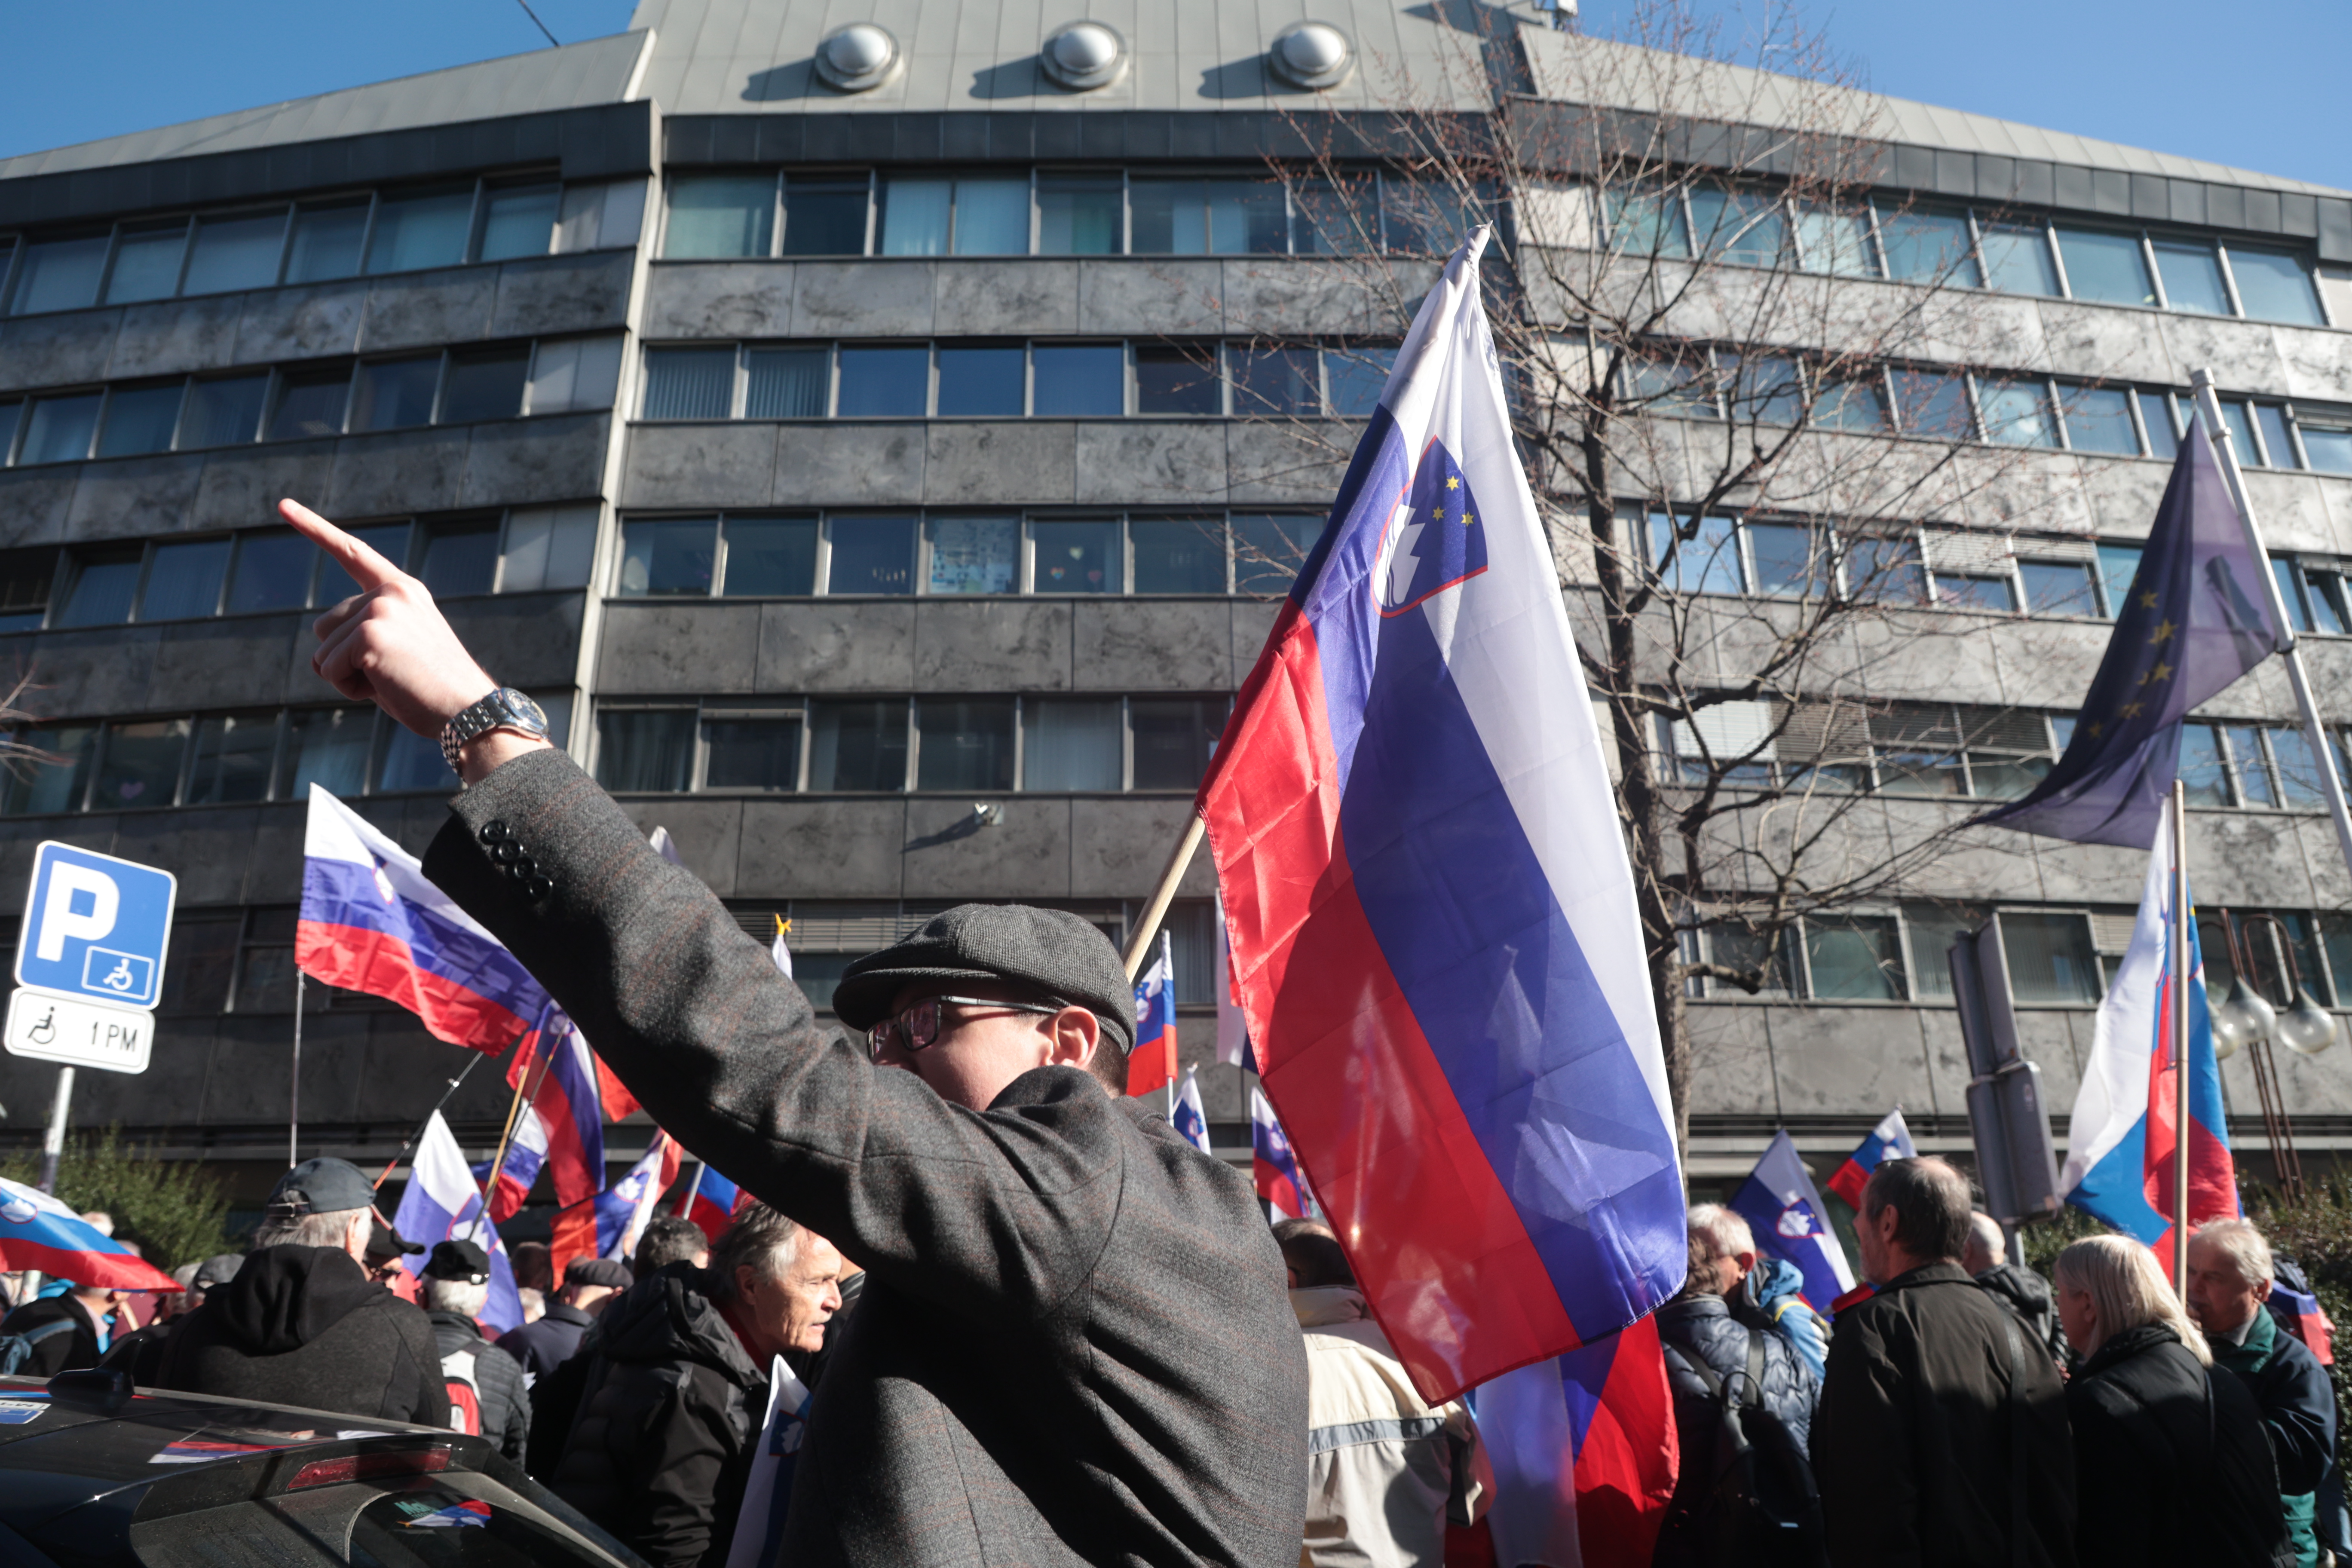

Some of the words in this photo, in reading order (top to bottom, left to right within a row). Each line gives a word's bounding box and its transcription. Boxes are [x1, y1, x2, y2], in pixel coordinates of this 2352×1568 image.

[37, 860, 120, 962] P
[92, 1021, 98, 1045] 1
[105, 1023, 138, 1052] PM
